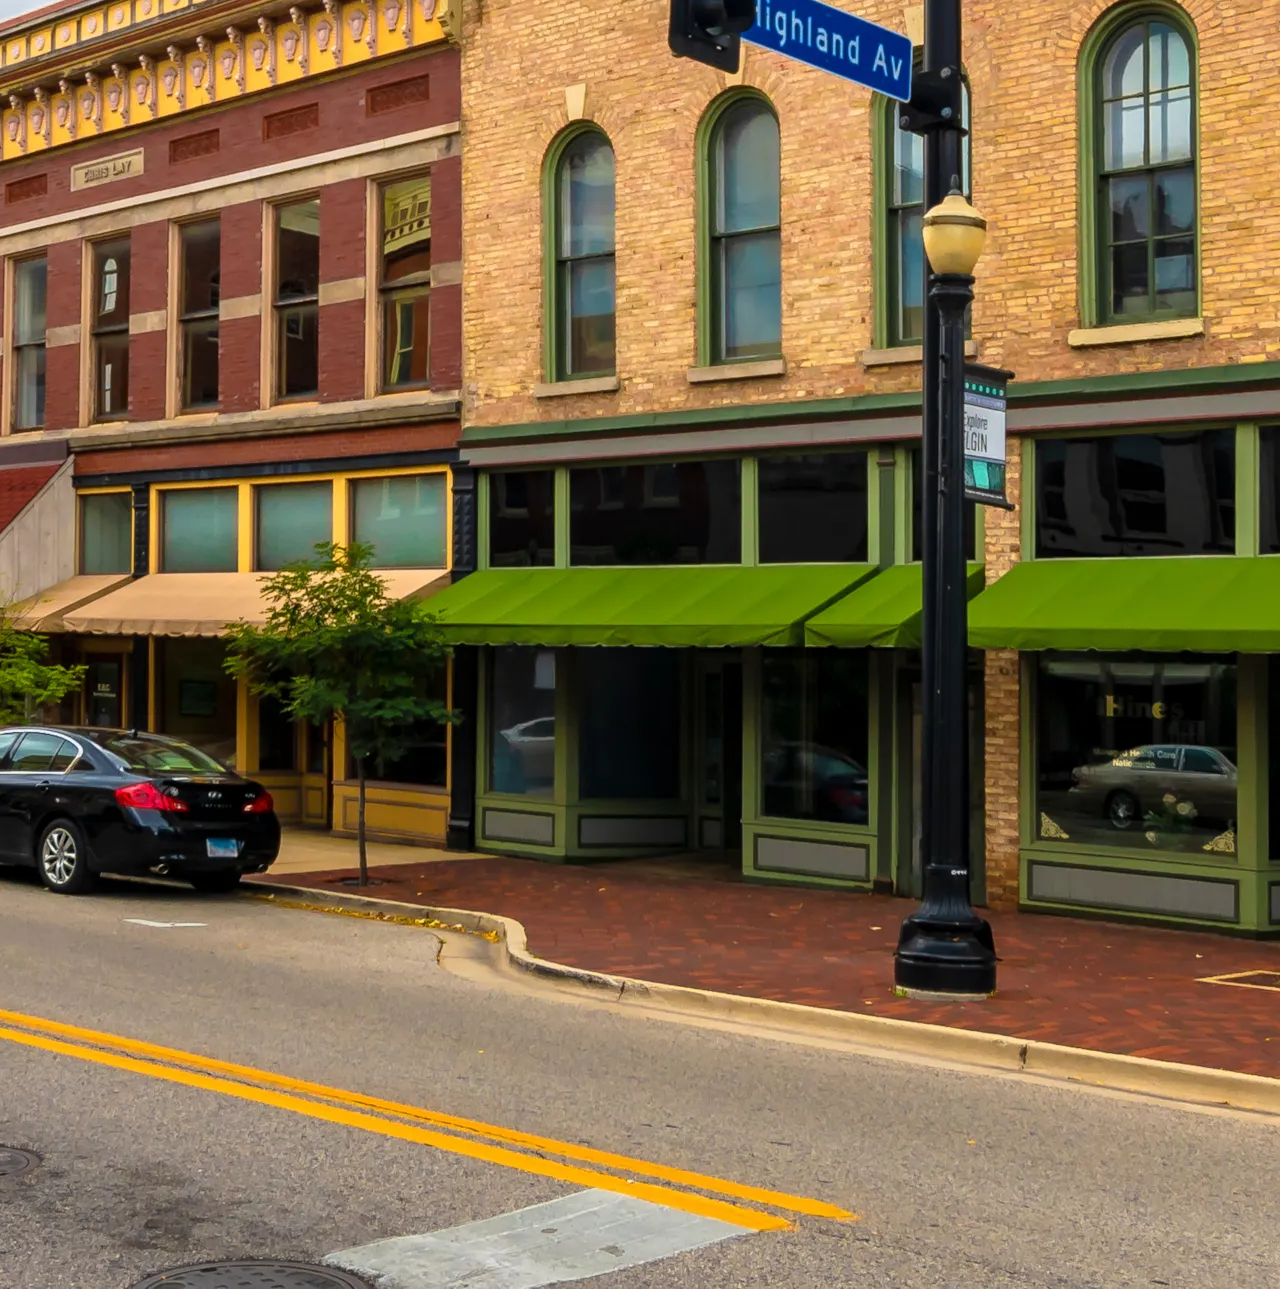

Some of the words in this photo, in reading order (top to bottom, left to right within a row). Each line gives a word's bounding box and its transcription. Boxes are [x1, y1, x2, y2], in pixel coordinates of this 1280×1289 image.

[872, 43, 903, 81] Av
[113, 159, 132, 176] LAY
[964, 430, 988, 453] LGIN
